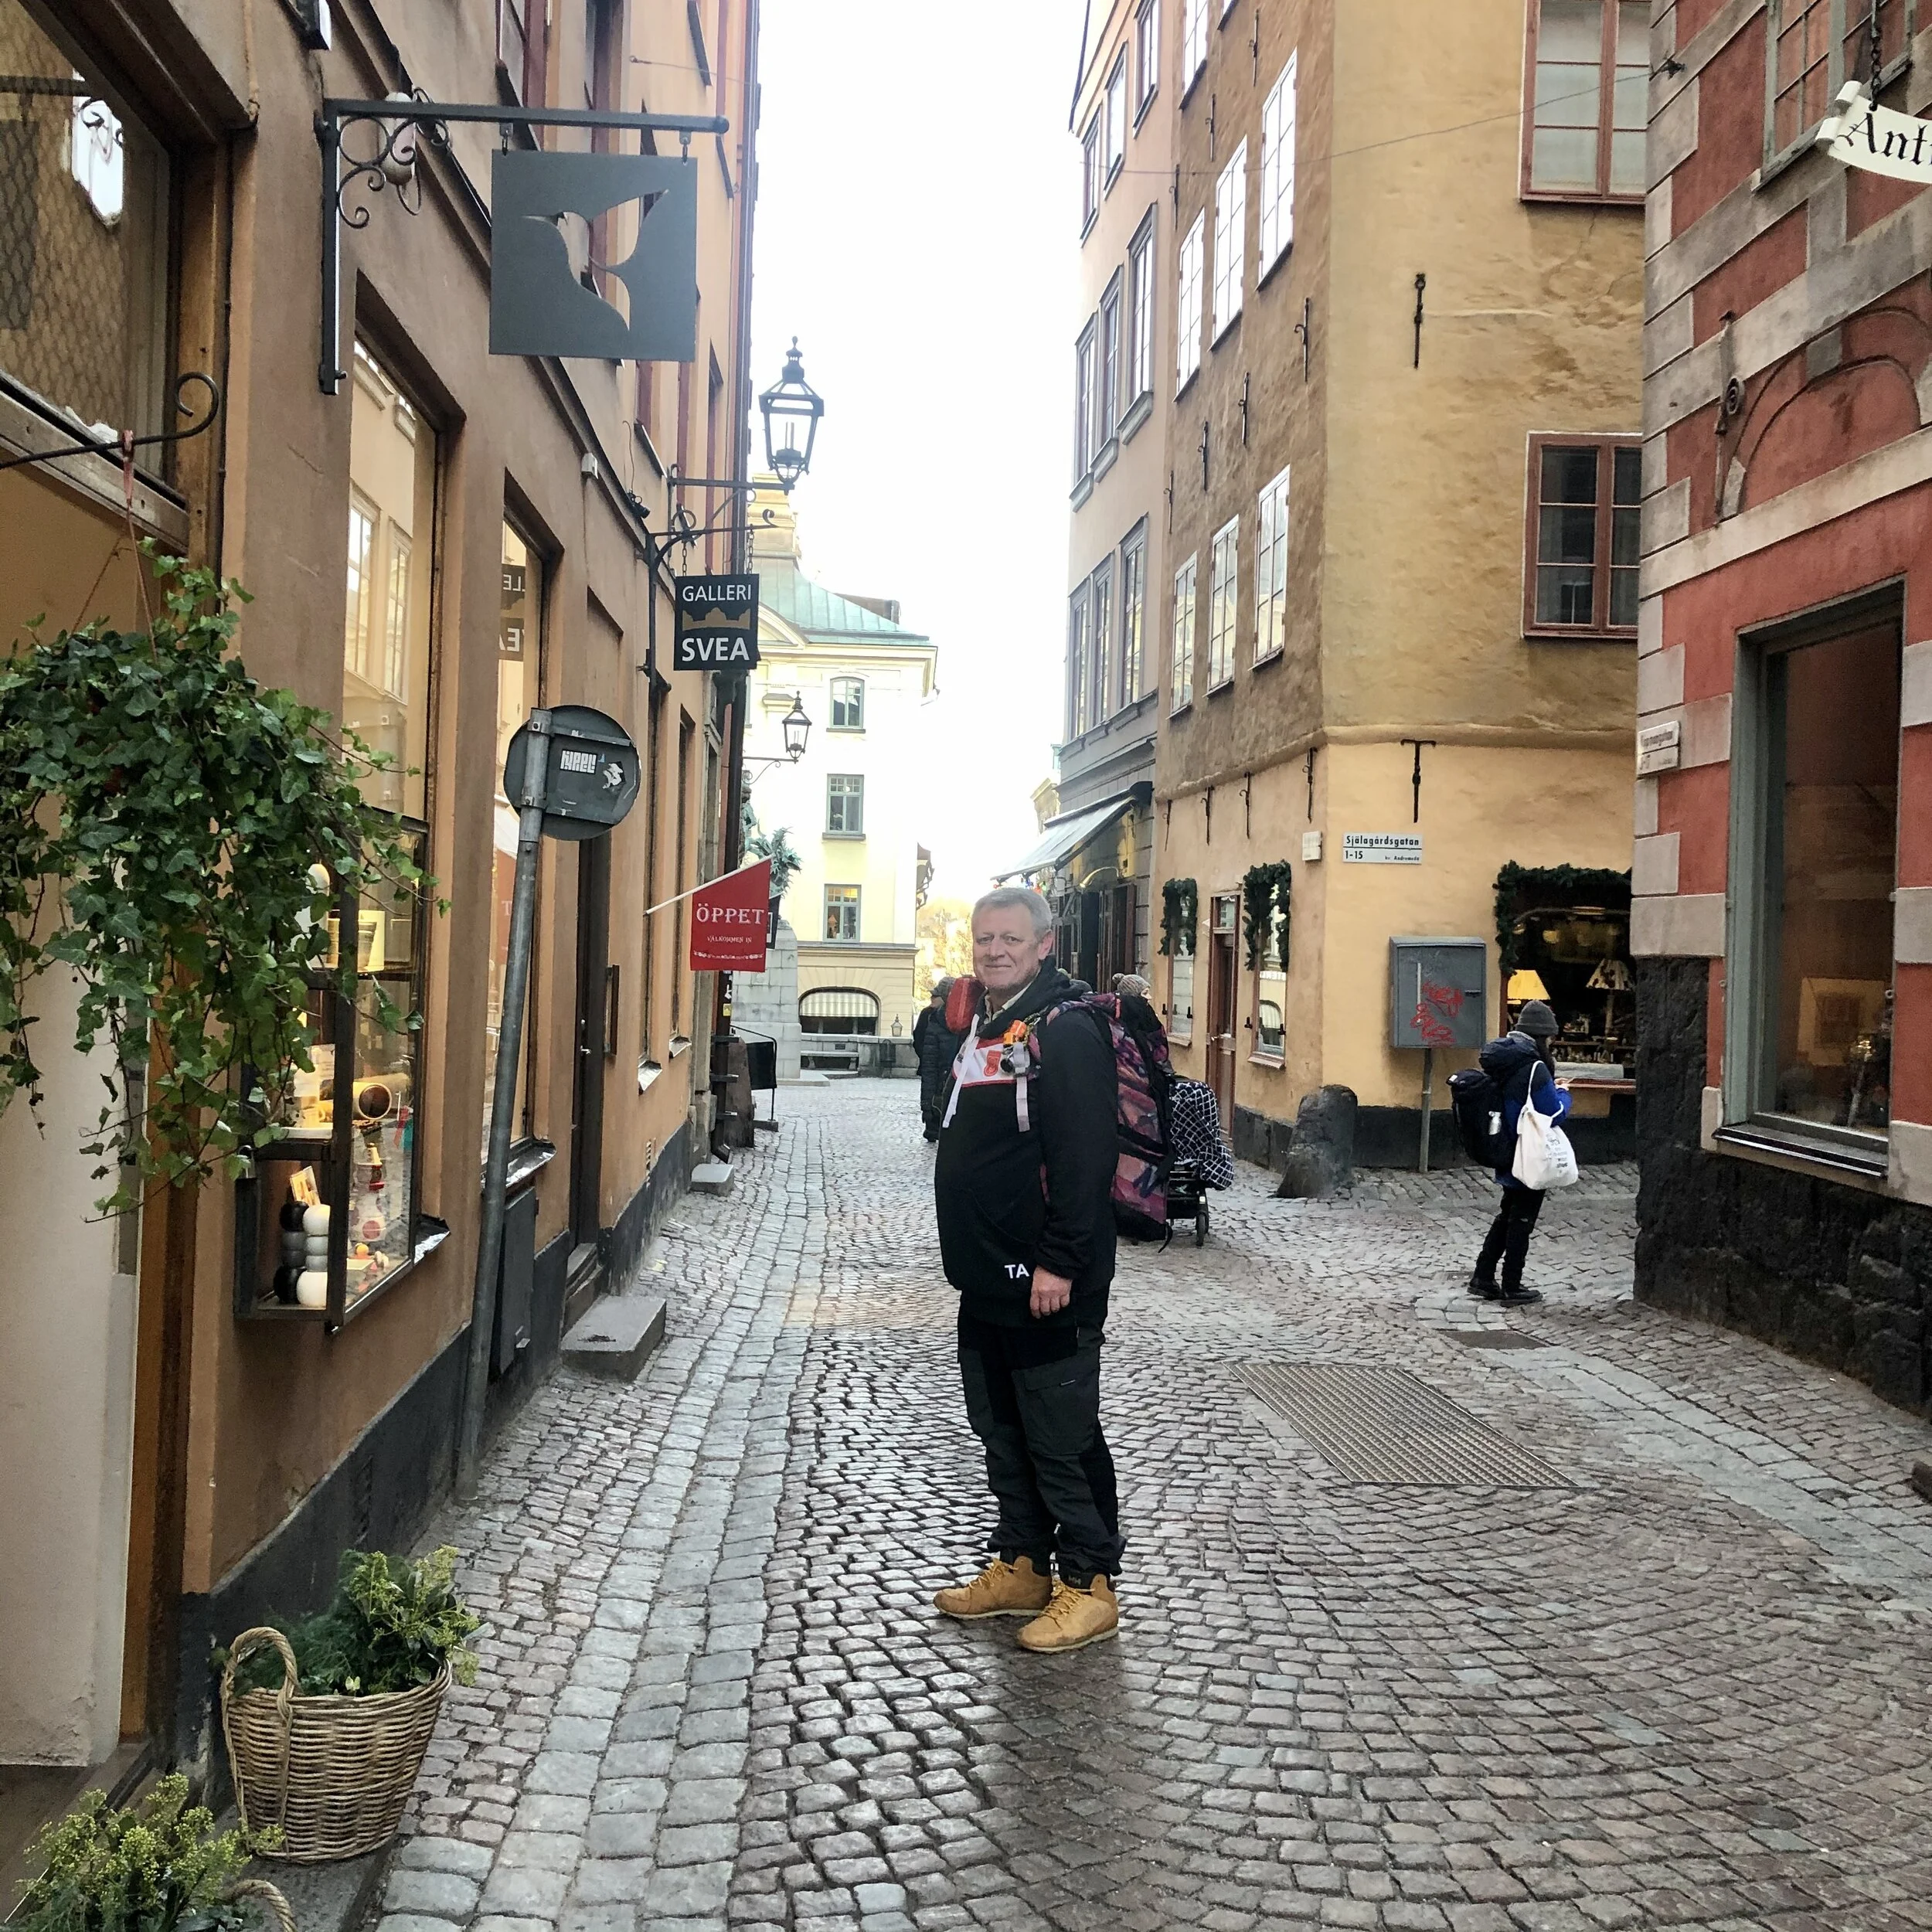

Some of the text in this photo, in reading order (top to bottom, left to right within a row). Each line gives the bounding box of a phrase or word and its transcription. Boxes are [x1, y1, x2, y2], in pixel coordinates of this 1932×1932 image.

[1837, 112, 1932, 165] Ant
[682, 584, 751, 602] GALLERI
[682, 637, 750, 662] SVEA
[1346, 835, 1420, 847] Själagårdsgatan
[1345, 850, 1363, 859] 1-15
[696, 903, 764, 924] ÖPPET
[1004, 1263, 1030, 1279] TA
